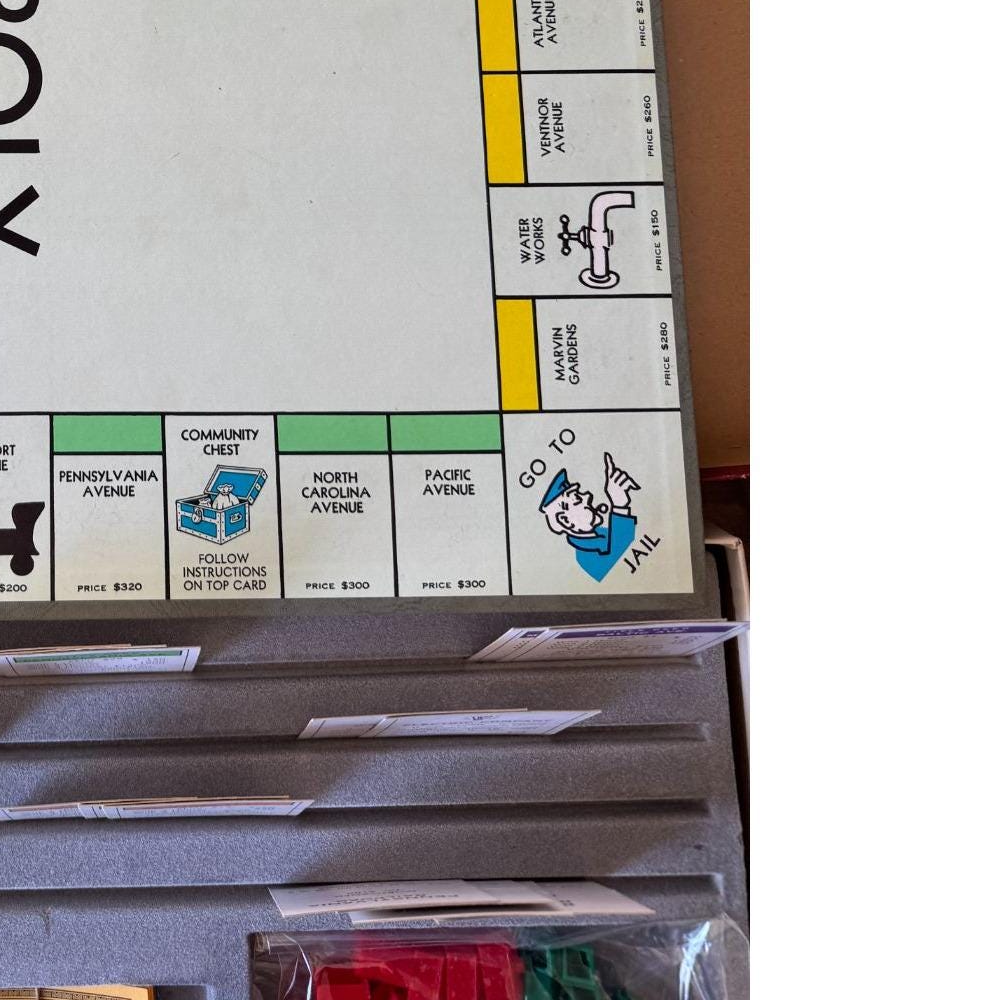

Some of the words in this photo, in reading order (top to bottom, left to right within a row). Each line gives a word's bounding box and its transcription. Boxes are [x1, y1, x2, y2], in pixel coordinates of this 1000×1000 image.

[538, 98, 551, 156] VENTNOR
[552, 102, 565, 153] AVENUE
[519, 219, 531, 263] WATER
[533, 218, 545, 264] WORKS
[552, 328, 565, 381] MARVIN
[566, 324, 579, 384] GARDENS
[181, 429, 259, 441] COMMUNITY
[203, 444, 240, 455] CHEST
[518, 459, 547, 489] GO
[548, 428, 576, 456] TO
[60, 470, 158, 482] PENNSYLVANIA
[314, 472, 358, 483] NORTH
[425, 469, 471, 481] PACIFIC
[83, 485, 135, 497] AVENUE
[302, 487, 371, 498] CAROLINA
[423, 484, 475, 495] AVENUE
[311, 502, 363, 513] AVENUE
[199, 553, 249, 564] FOLLOW
[622, 534, 661, 574] JAIL
[183, 566, 266, 577] INSTRUCTIONS
[114, 583, 142, 591] $320
[184, 580, 202, 591] ON
[207, 580, 229, 590] TOP
[233, 580, 266, 590] CARD
